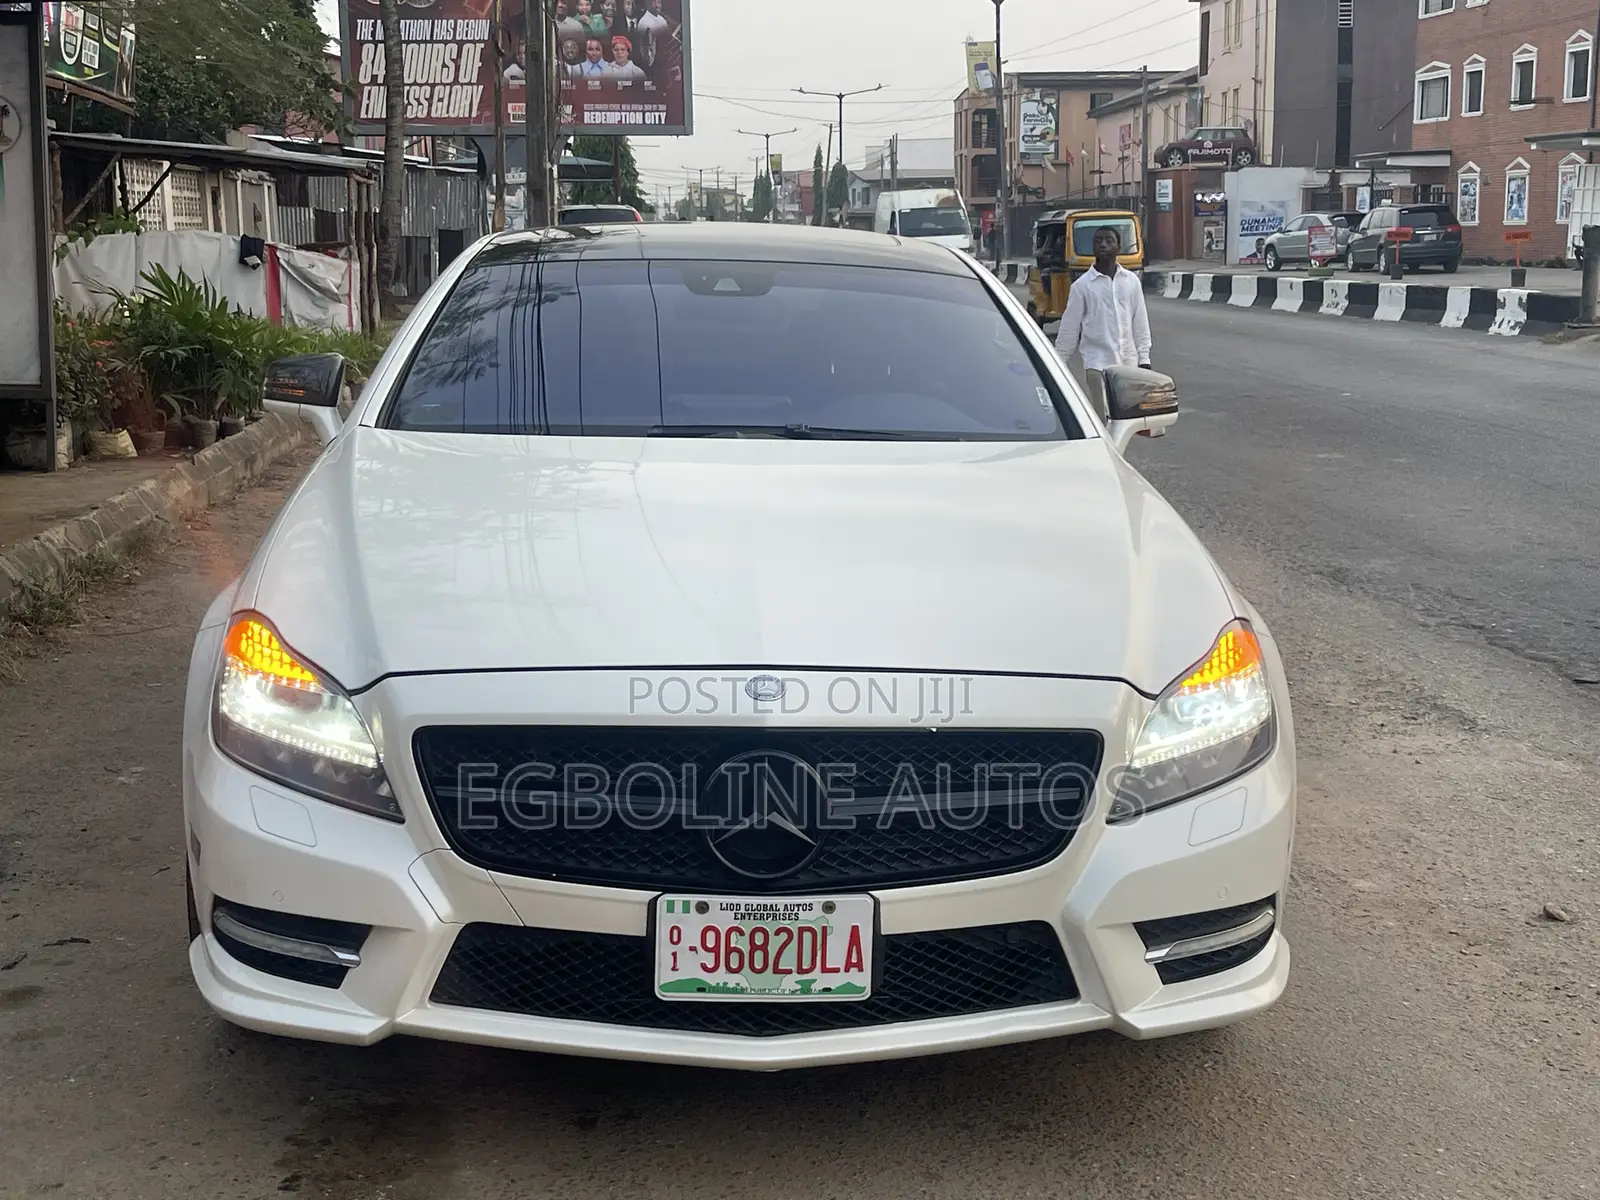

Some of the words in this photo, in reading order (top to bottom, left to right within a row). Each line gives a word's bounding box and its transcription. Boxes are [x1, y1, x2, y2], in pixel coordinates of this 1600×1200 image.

[356, 19, 375, 40] THE
[375, 19, 433, 41] MATHON
[433, 19, 454, 40] HAS
[456, 19, 490, 41] BEGUN
[358, 43, 387, 84] 84
[402, 43, 458, 84] OURS
[458, 43, 485, 84] OF
[360, 85, 431, 119] ENSS
[430, 85, 484, 118] GLORY
[583, 111, 643, 124] REDEMPTION
[644, 111, 667, 124] CITY
[1240, 216, 1284, 226] DUNAMIS
[719, 902, 742, 912] LIOD
[745, 902, 780, 912] GLOBAL
[783, 902, 814, 912] AUTOS
[733, 912, 800, 921] ENTERPRISES
